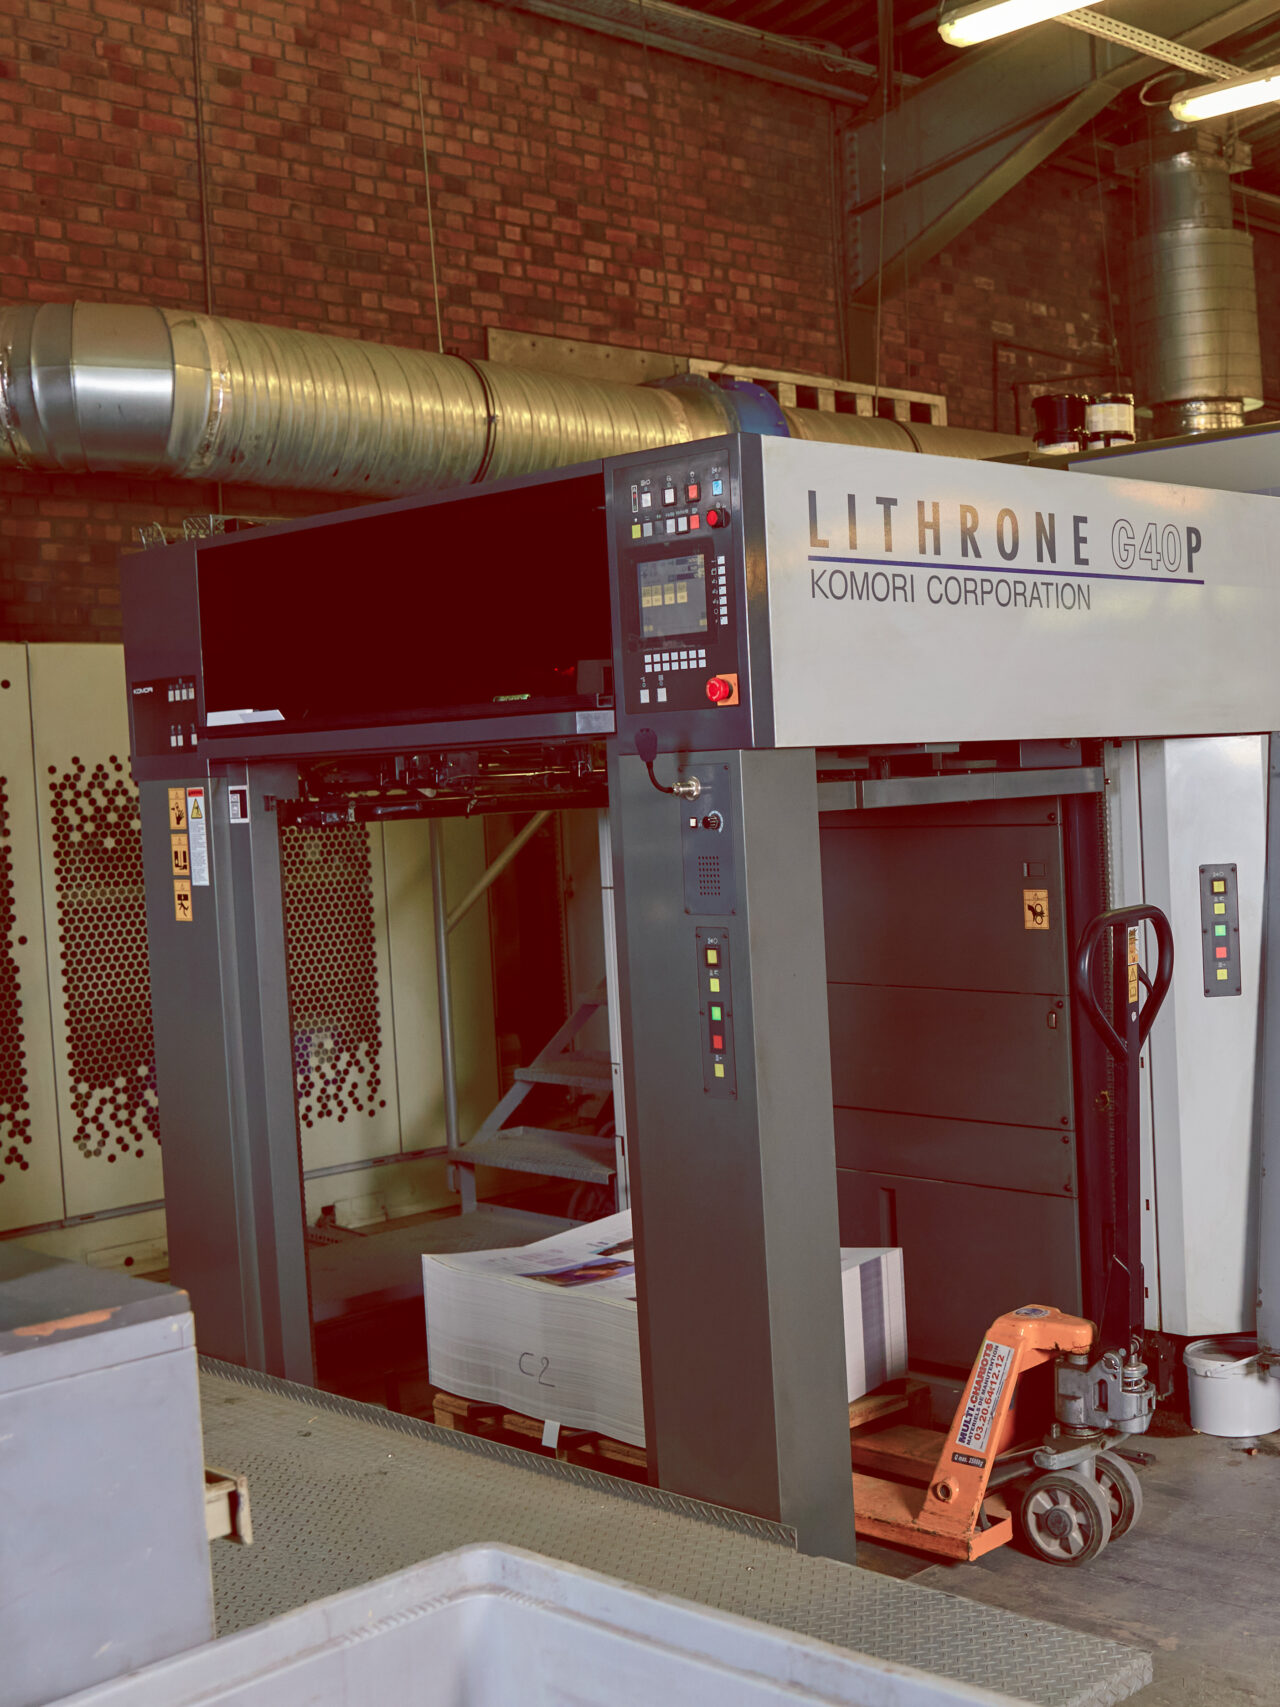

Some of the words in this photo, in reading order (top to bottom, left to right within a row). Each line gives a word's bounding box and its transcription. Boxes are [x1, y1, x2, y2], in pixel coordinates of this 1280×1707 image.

[808, 490, 1090, 566] LITHRONE
[1111, 518, 1202, 573] G40P
[811, 569, 915, 603] KOMORI
[927, 575, 1091, 610] CORPORATION
[518, 1351, 556, 1388] C2
